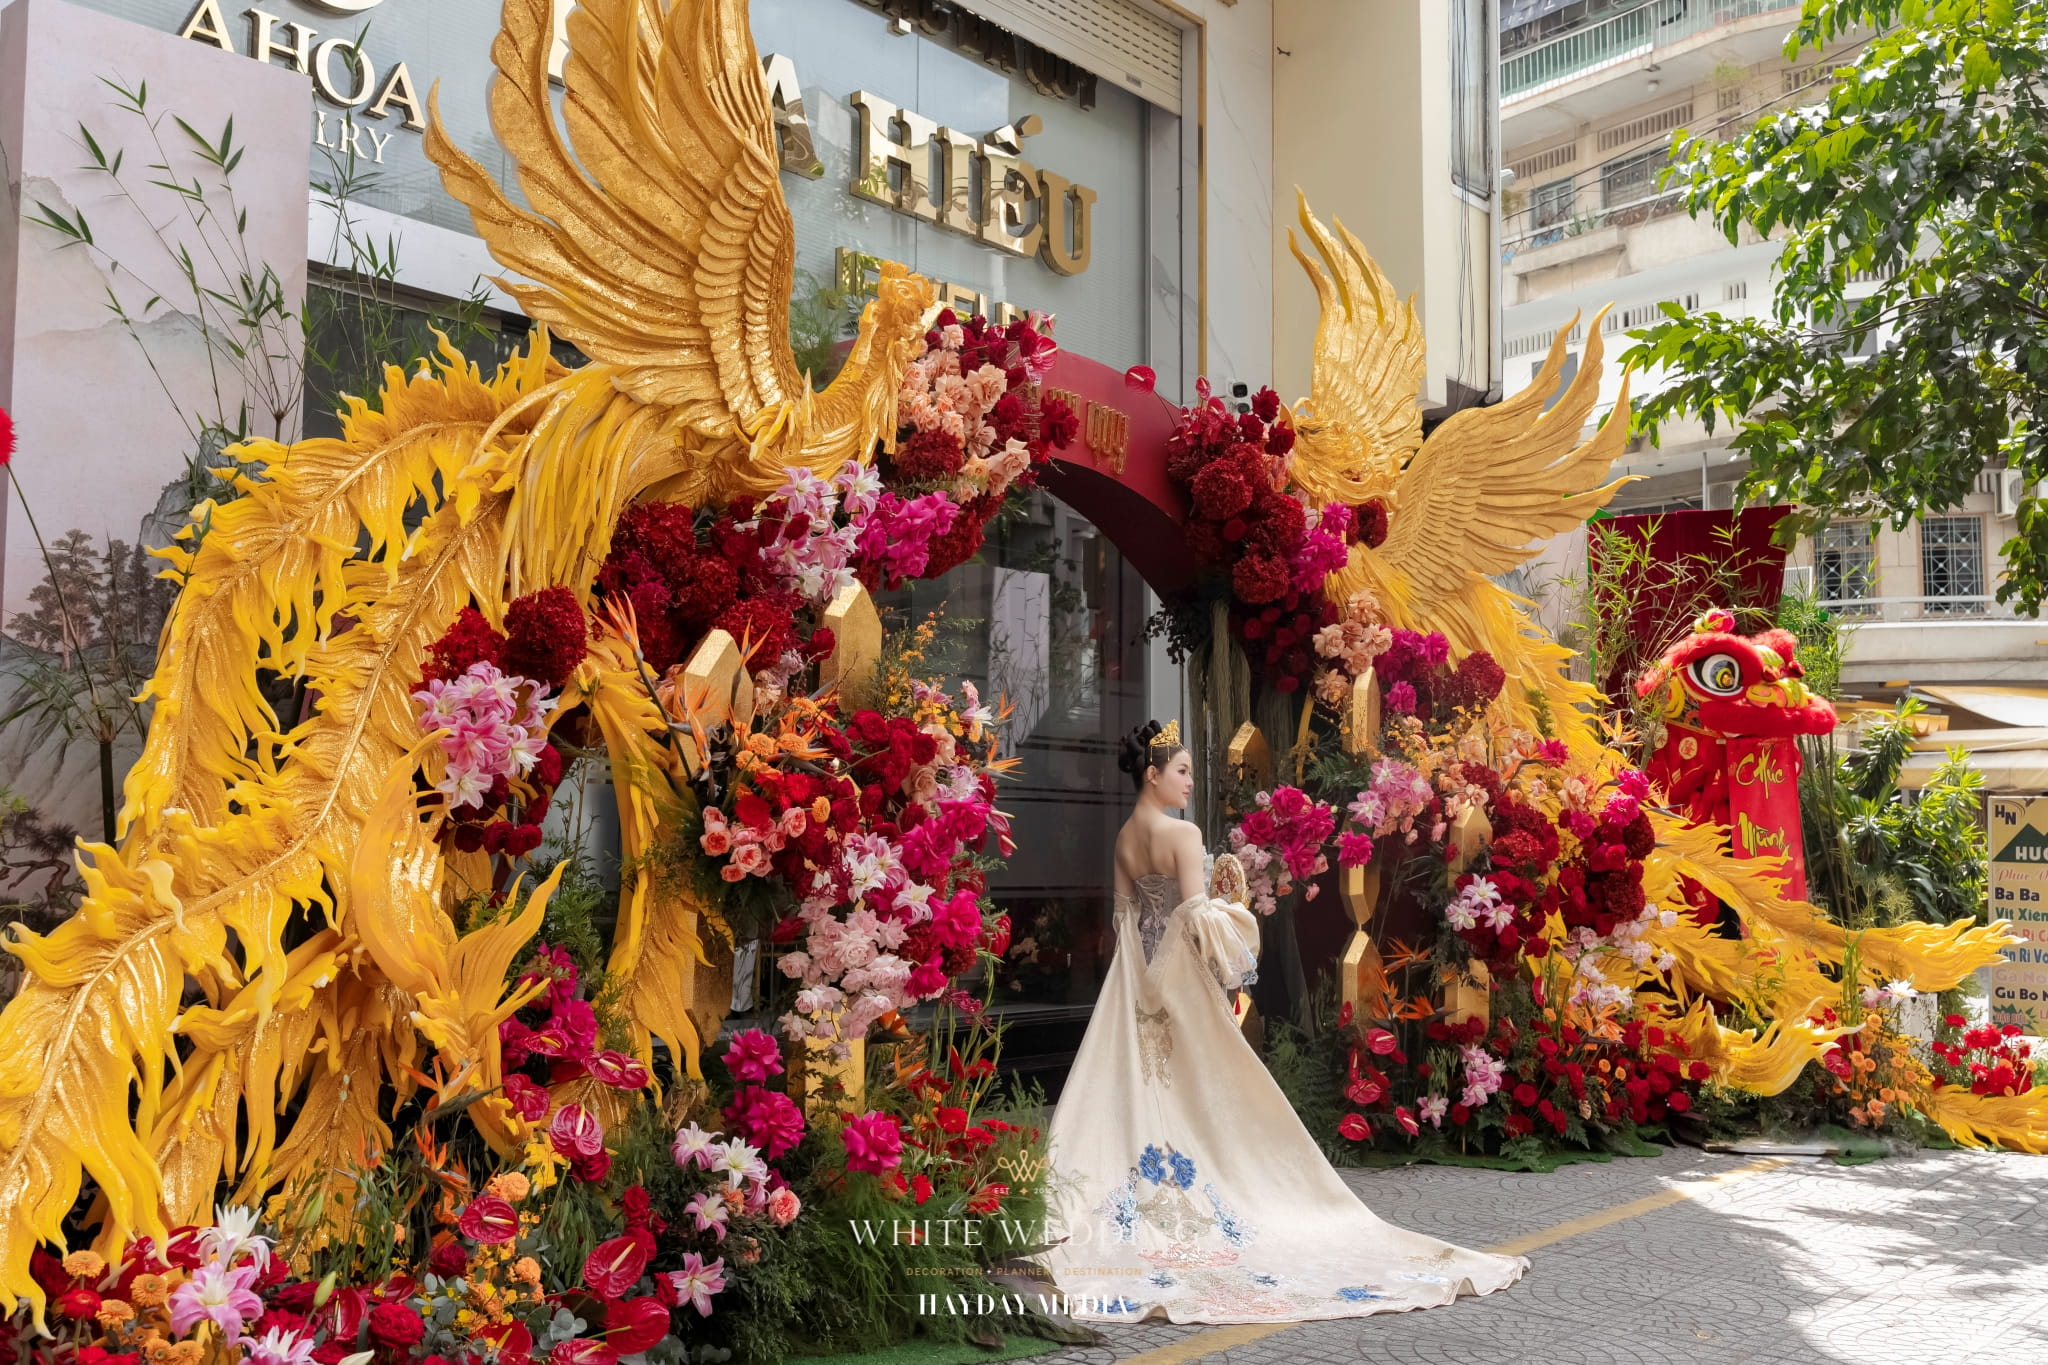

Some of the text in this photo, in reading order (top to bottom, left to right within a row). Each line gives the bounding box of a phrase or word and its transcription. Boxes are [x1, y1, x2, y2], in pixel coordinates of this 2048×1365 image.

[1995, 887, 2040, 902] Ba Ba
[2019, 948, 2030, 962] Ri
[1995, 986, 2015, 999] Gu
[2020, 988, 2038, 1001] Bo
